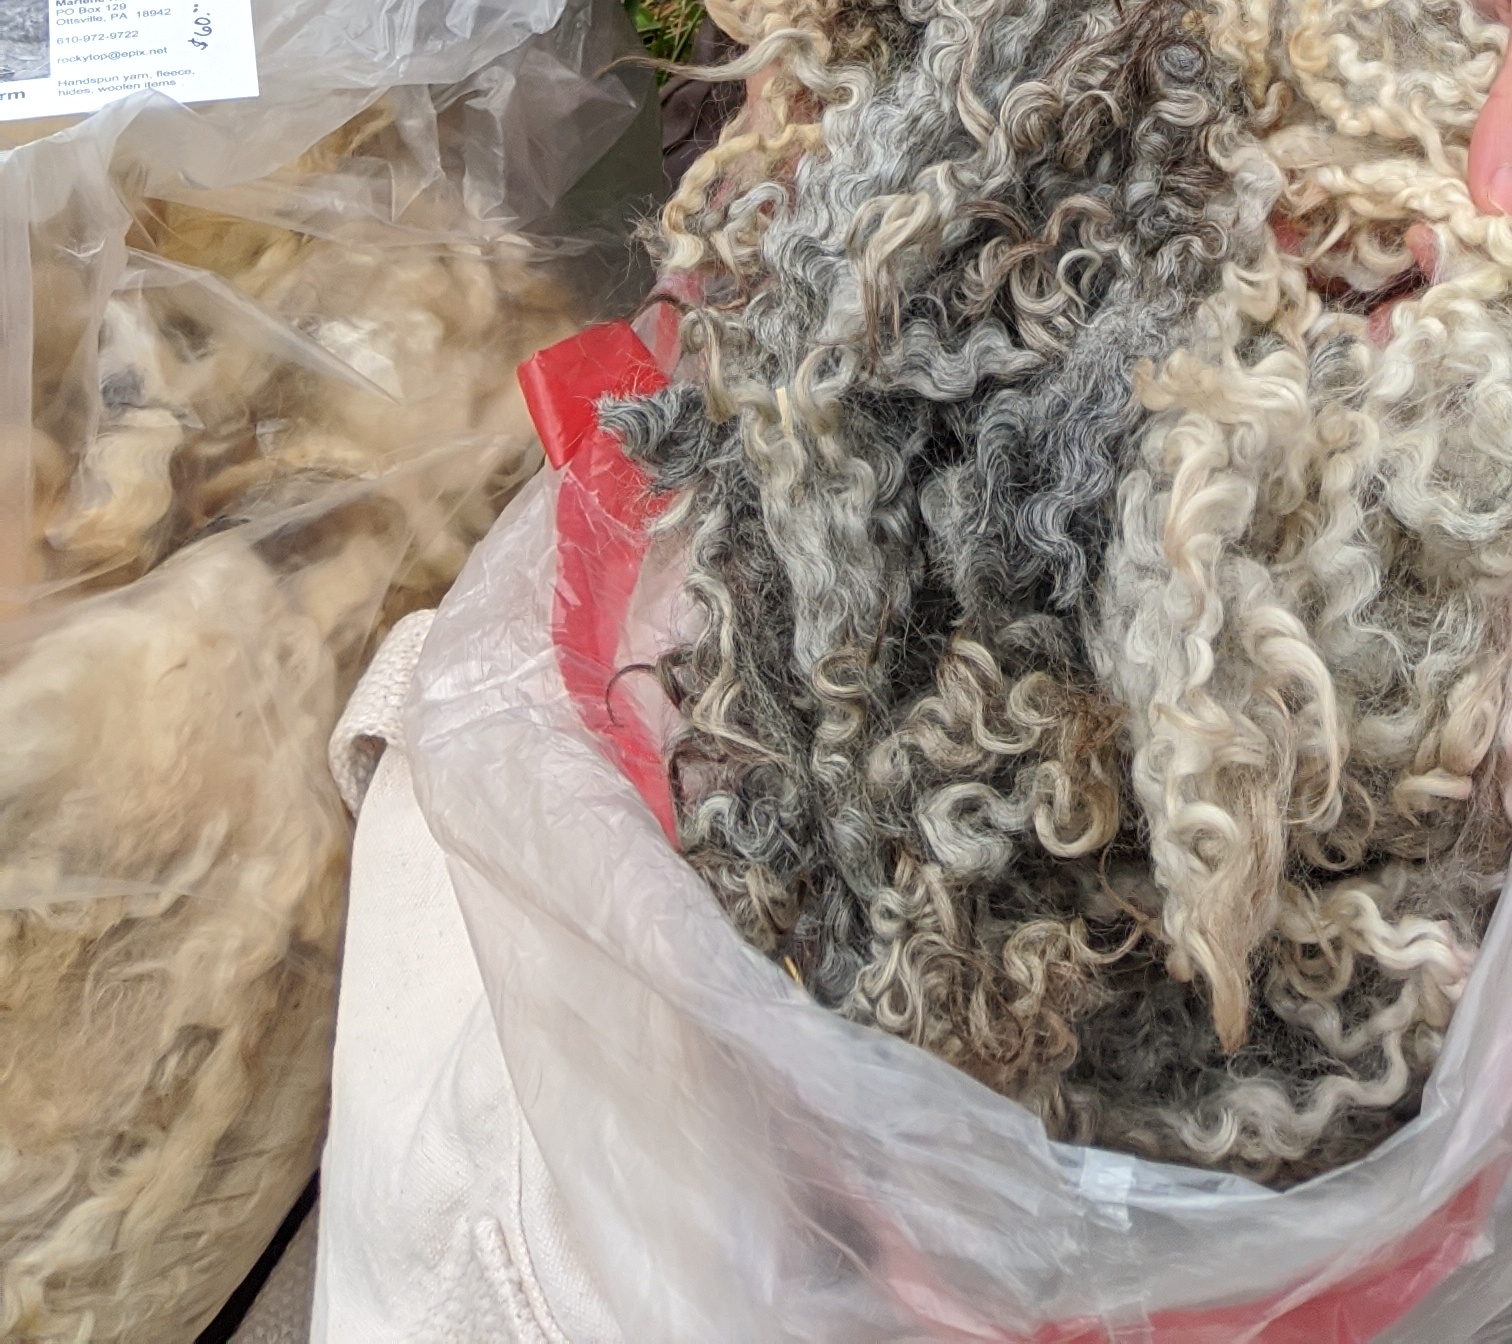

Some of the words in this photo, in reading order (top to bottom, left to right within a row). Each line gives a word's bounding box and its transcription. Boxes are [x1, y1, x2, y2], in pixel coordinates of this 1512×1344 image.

[56, 8, 75, 16] PO
[78, 6, 101, 14] Box
[105, 3, 127, 11] 129
[110, 12, 128, 21] PA
[136, 8, 171, 18] 18942
[56, 30, 139, 44] 610-972-9722
[57, 46, 168, 64] rockytop@epix.net
[58, 75, 119, 87] Handspun
[97, 82, 141, 93] woolen
[144, 78, 176, 89] items
[0, 91, 25, 101] rm
